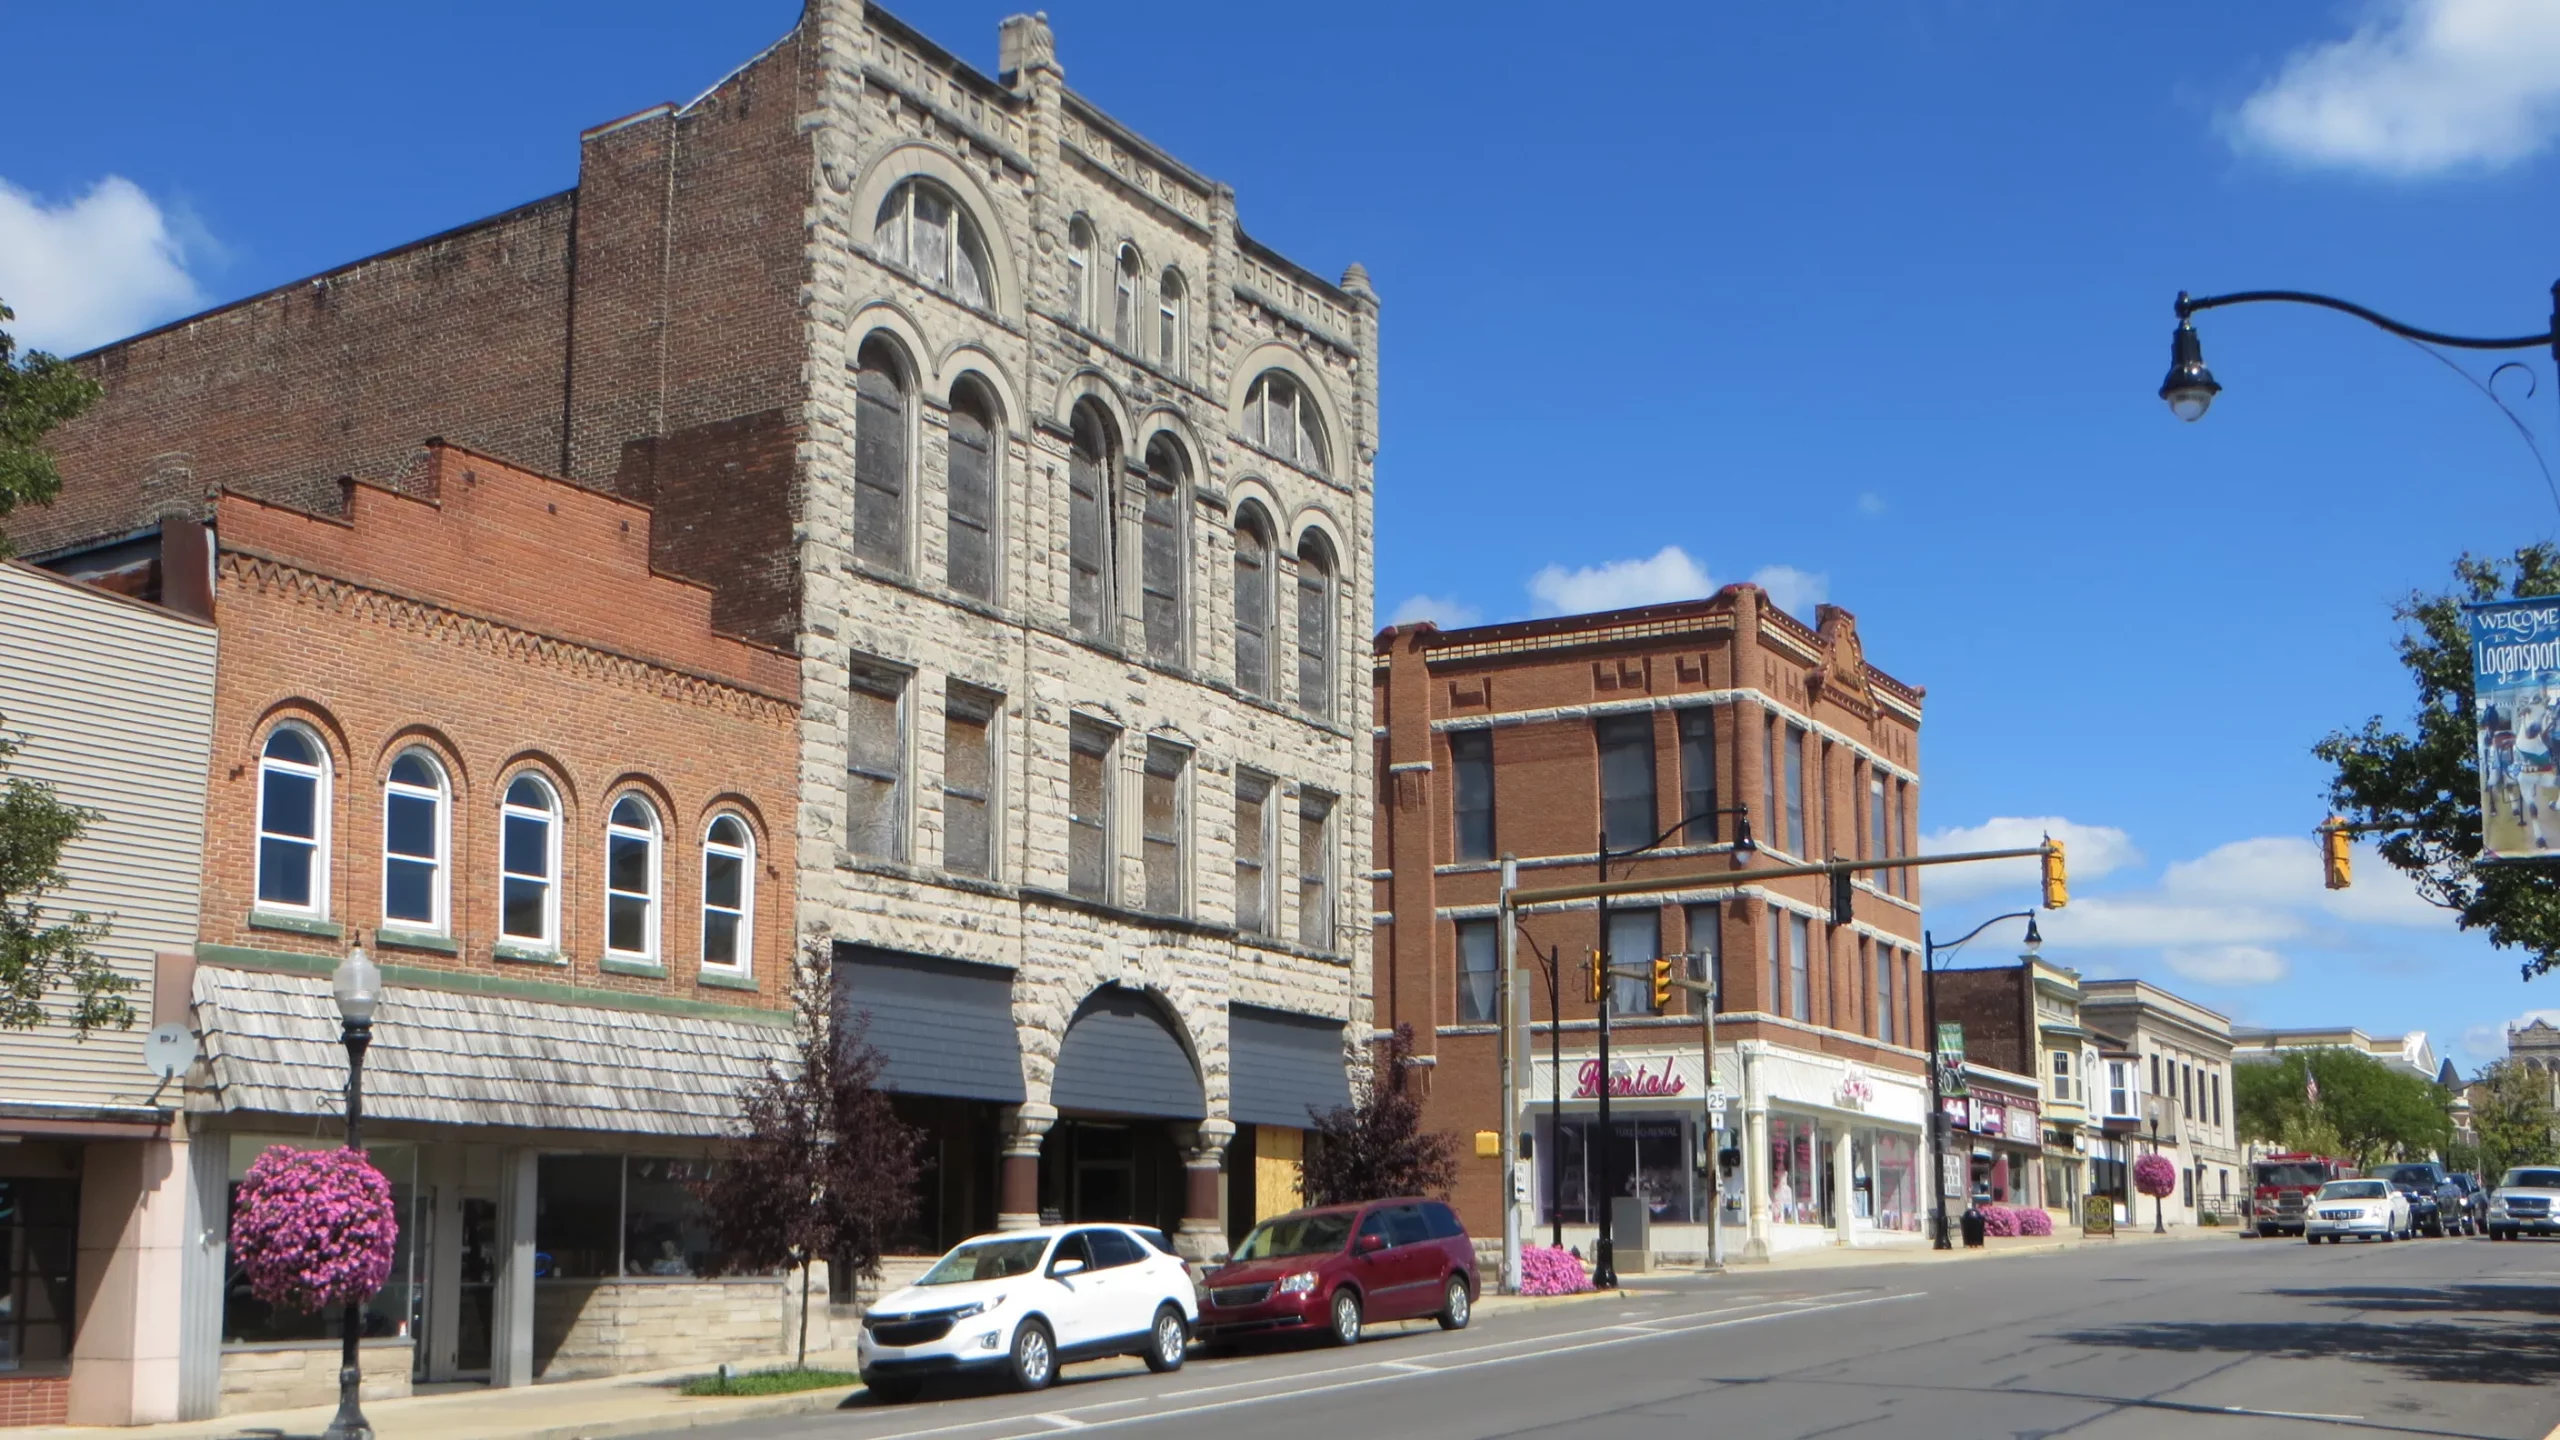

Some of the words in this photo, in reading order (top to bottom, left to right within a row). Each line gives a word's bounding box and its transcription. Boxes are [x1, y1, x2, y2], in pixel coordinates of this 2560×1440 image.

[2478, 608, 2559, 642] WELCOME
[2479, 637, 2560, 685] Logansport
[1577, 1056, 1686, 1097] Rentals
[1709, 1094, 1725, 1109] 25
